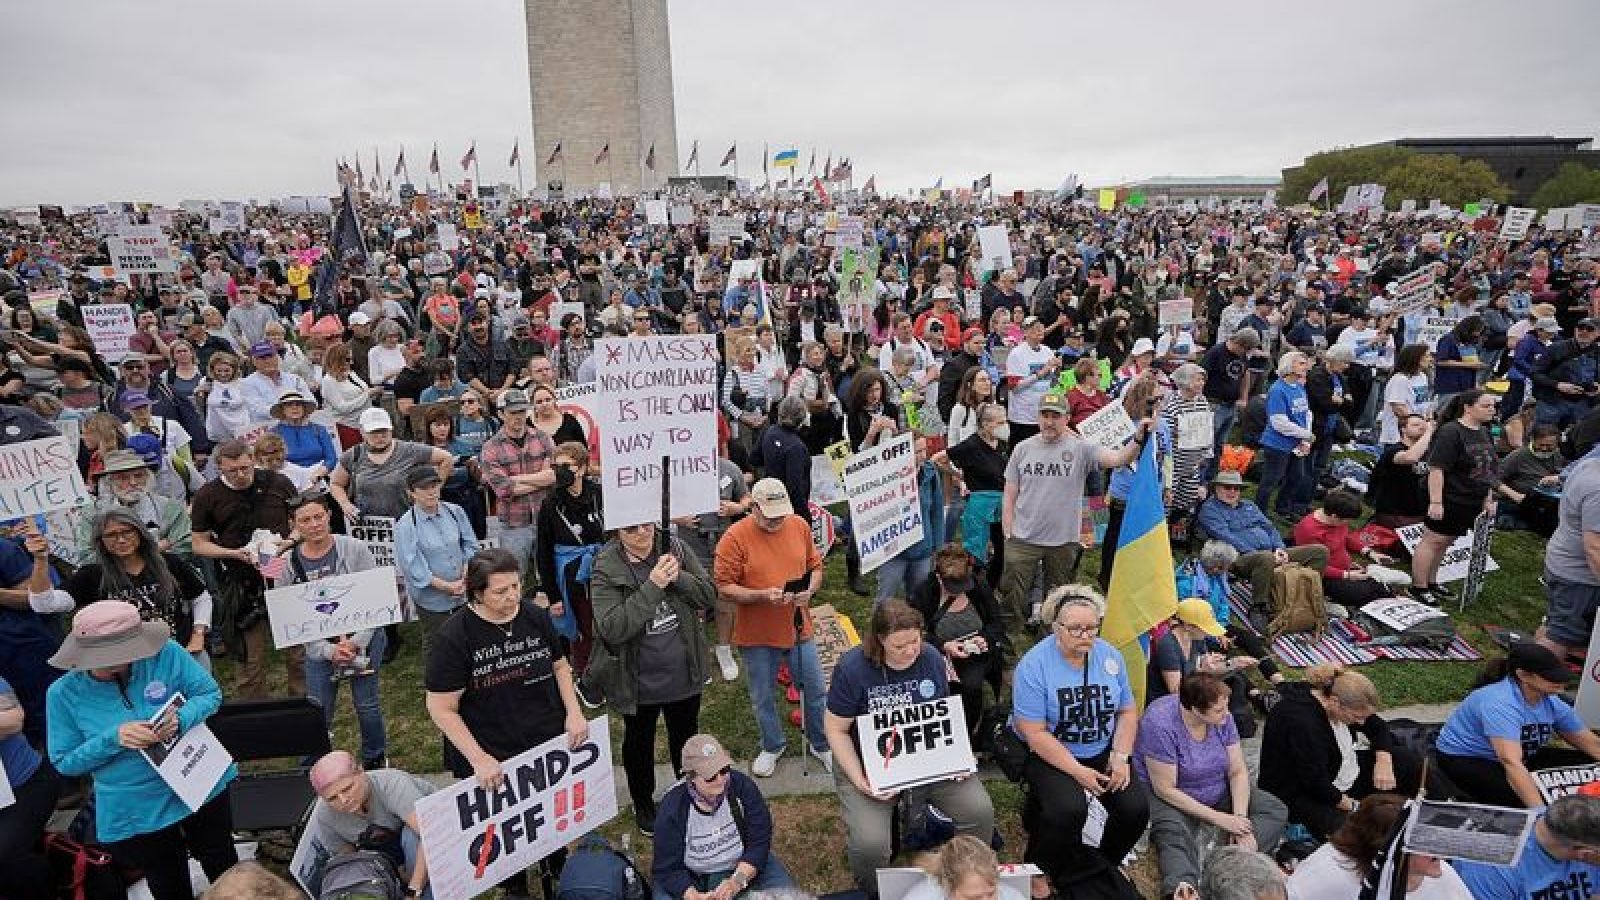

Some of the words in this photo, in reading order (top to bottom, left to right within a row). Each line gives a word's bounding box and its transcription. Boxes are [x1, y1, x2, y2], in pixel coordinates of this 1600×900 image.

[627, 339, 698, 364] MASS
[556, 384, 597, 401] LOWN
[617, 399, 639, 423] IS
[646, 395, 674, 416] THE
[677, 391, 715, 415] ONLY
[612, 431, 655, 455] WAY
[668, 427, 693, 445] TO
[0, 442, 73, 480] INAS
[617, 463, 662, 488] END
[670, 448, 718, 477] THIS!
[846, 455, 879, 476] HANDS
[881, 440, 911, 461] OFF!
[1023, 462, 1073, 478] ARMY
[855, 490, 897, 514] CANADA
[351, 529, 395, 543] OFF!
[860, 512, 922, 558] AMERICA
[903, 679, 920, 692] TO
[873, 699, 949, 731] HANDS
[877, 719, 954, 760] OFF!
[455, 742, 600, 831] HANDS
